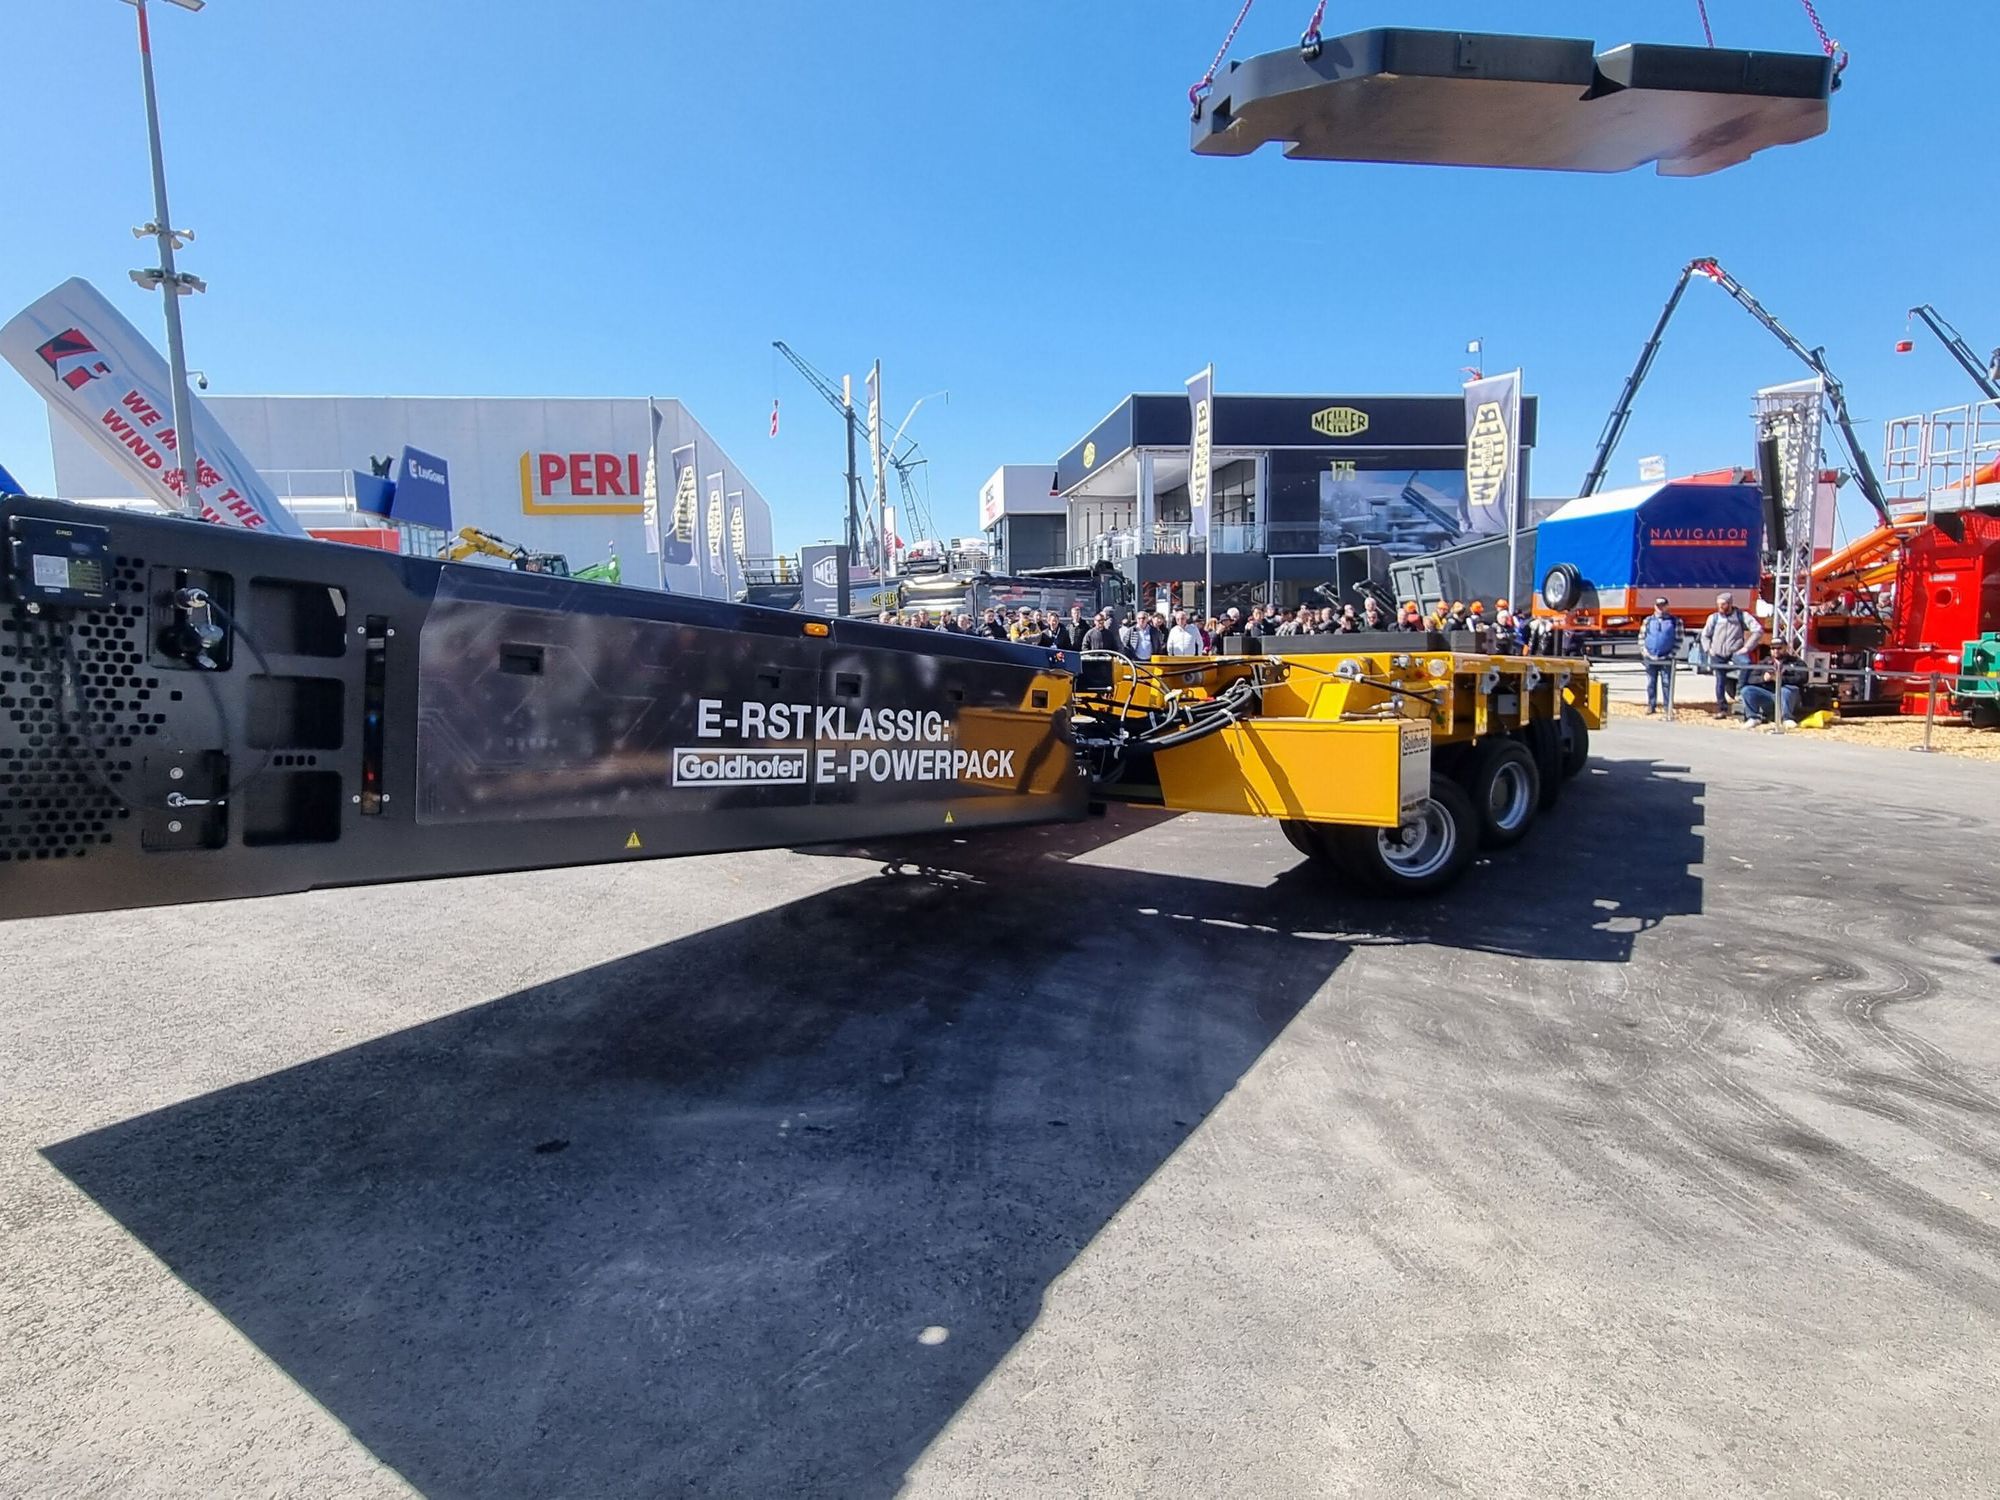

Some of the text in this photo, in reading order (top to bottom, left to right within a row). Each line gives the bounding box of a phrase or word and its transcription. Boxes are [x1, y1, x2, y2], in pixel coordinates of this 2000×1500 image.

[102, 408, 162, 469] WIND
[1314, 409, 1366, 433] MEILLER
[122, 390, 162, 427] WE
[218, 488, 267, 530] THE
[539, 453, 640, 496] PERI
[1470, 408, 1505, 501] MEILLER
[1650, 528, 1748, 539] NAVIGATOR
[679, 749, 1015, 784] Goldhofer E-POWERPACK
